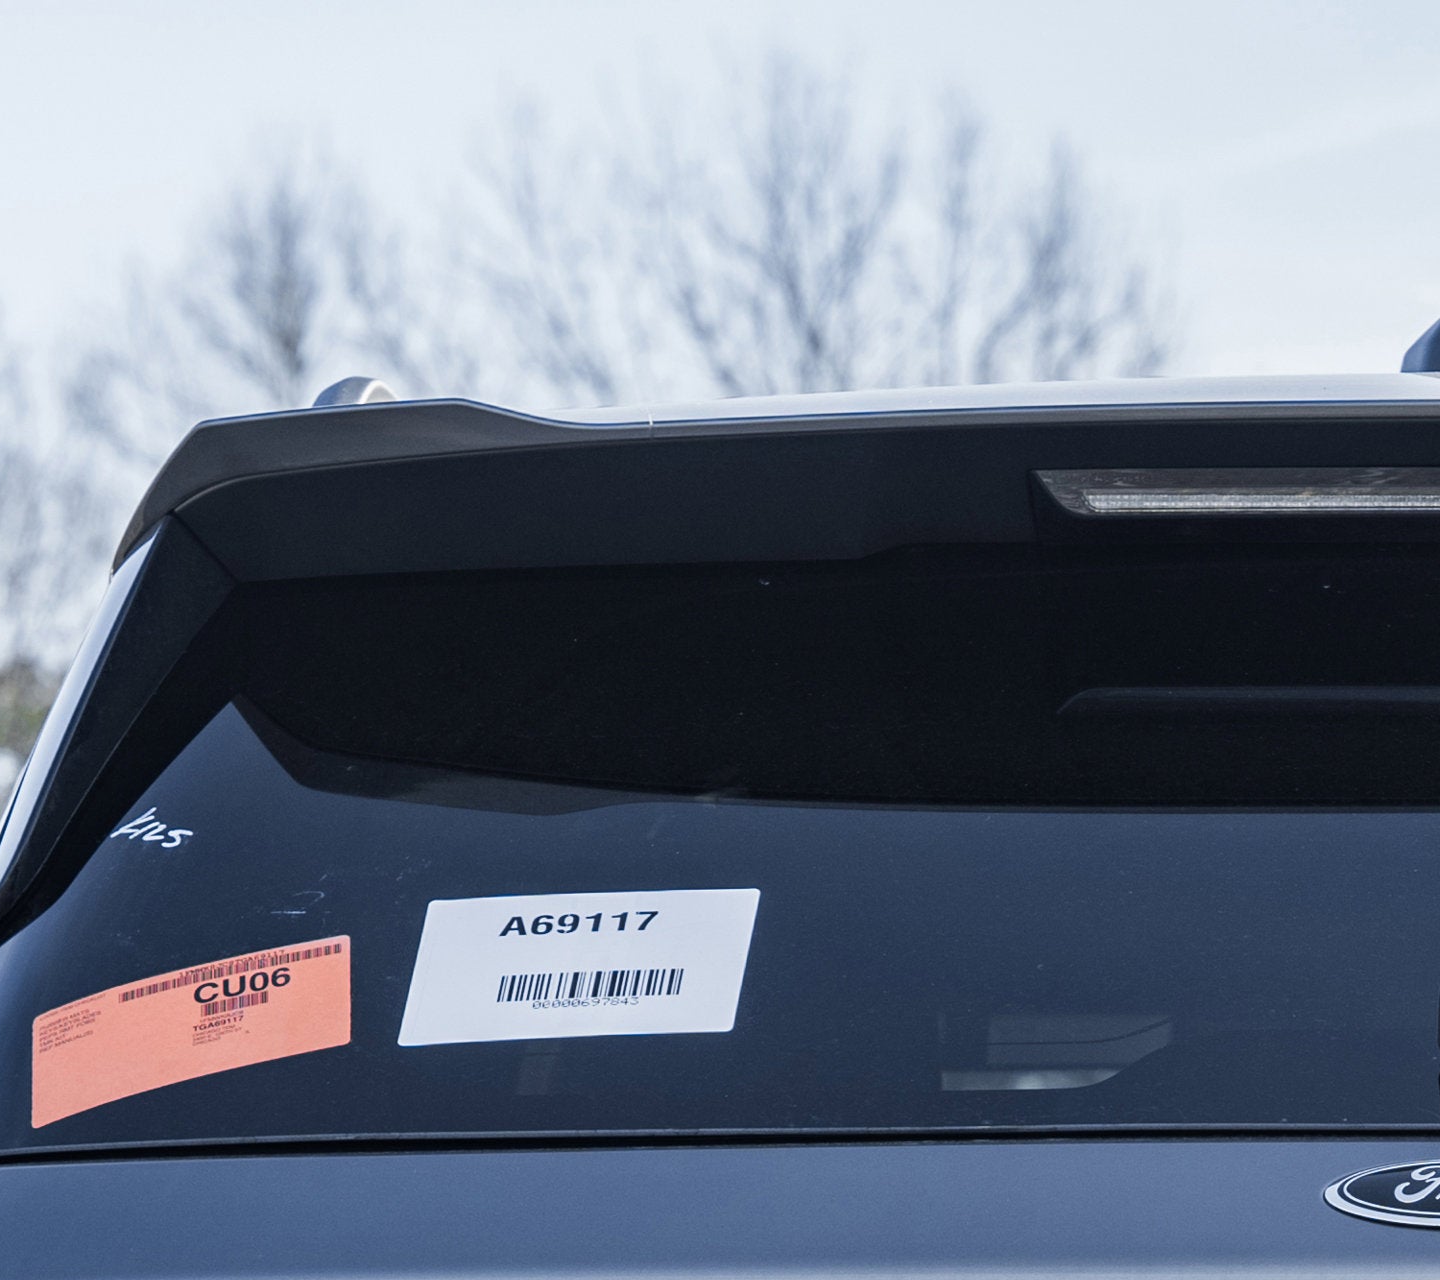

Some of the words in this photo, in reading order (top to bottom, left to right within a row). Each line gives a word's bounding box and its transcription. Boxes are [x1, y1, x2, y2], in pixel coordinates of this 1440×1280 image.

[498, 910, 659, 937] A69117
[193, 967, 291, 1004] CU06
[192, 1014, 245, 1032] TGA69117
